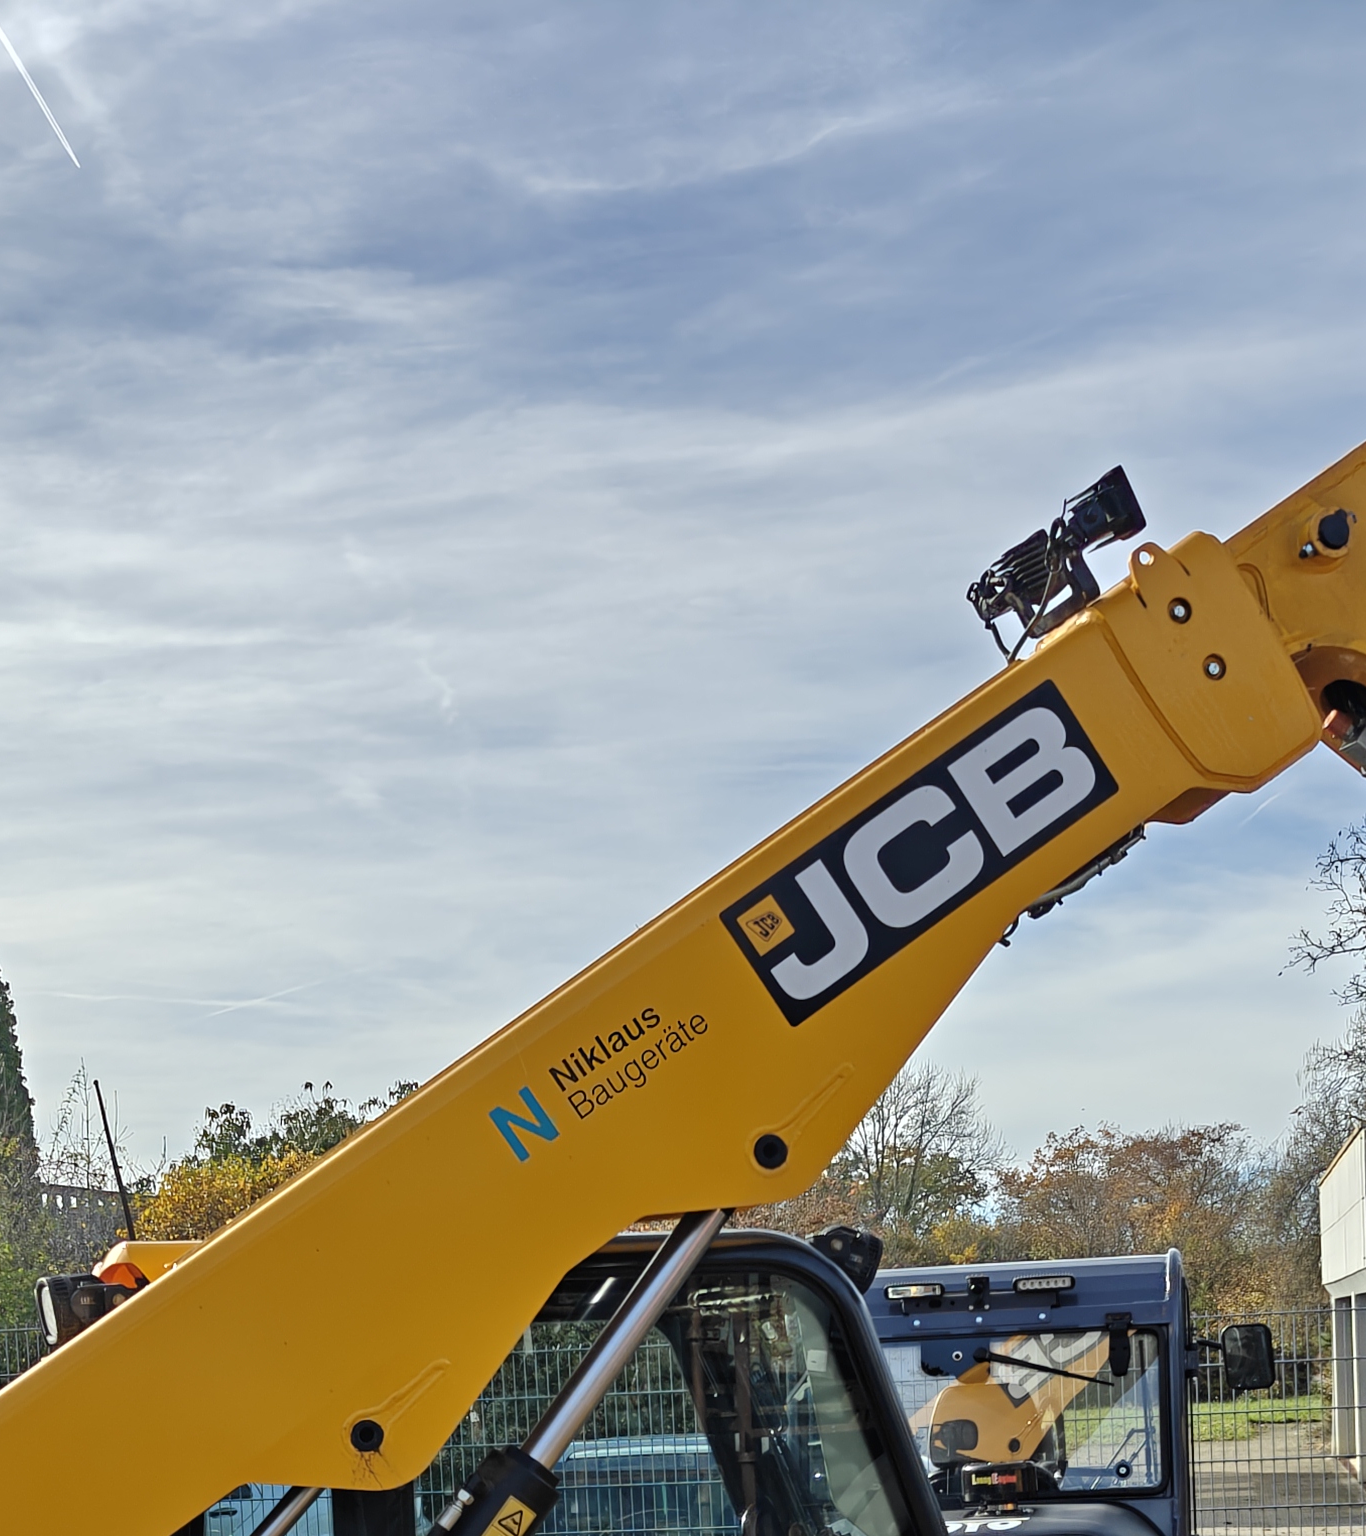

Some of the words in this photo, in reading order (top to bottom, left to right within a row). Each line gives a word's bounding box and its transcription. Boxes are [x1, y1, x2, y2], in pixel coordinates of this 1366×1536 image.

[769, 706, 1096, 1000] JCB
[752, 911, 782, 940] JCB
[548, 1006, 661, 1092] Niklaus
[567, 1014, 709, 1120] Baugeräte
[488, 1085, 560, 1163] N
